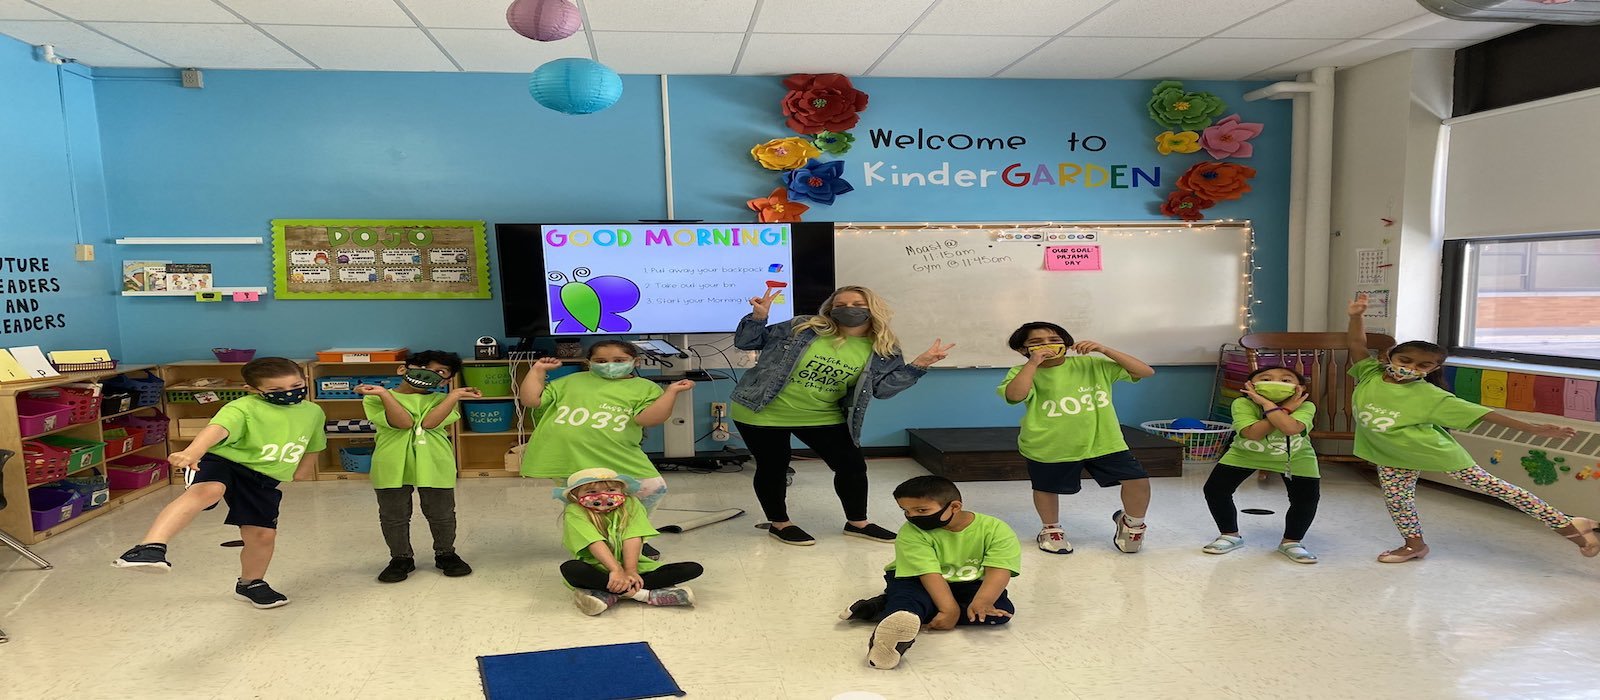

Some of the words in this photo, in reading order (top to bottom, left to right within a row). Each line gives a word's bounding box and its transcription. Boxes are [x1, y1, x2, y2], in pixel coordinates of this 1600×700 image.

[869, 128, 1027, 150] Welcome
[1068, 132, 1107, 152] to
[863, 161, 1161, 189] KinderGARDEN
[327, 227, 434, 247] DOJO
[545, 229, 632, 247] GOOD
[646, 227, 787, 247] MORNING!
[698, 267, 719, 275] your
[722, 265, 763, 274] backpack
[6, 298, 39, 313] AND
[684, 298, 705, 306] your
[707, 296, 742, 304] Morning
[805, 360, 854, 381] FIRST
[554, 405, 630, 432] 2033
